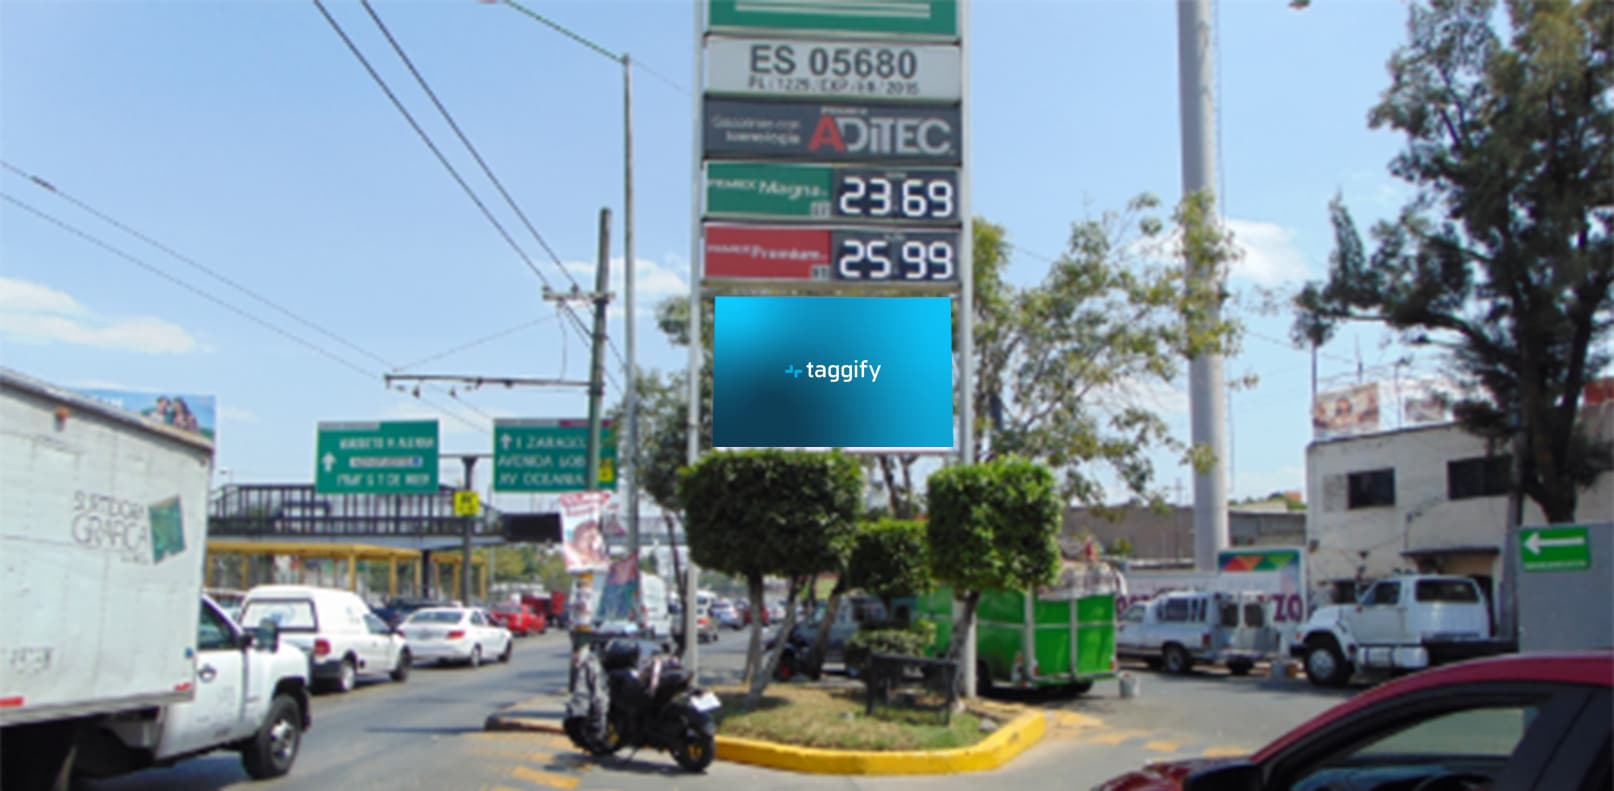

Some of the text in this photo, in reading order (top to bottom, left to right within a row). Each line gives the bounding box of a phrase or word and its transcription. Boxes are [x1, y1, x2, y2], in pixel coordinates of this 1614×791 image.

[751, 45, 917, 79] ES 05680
[758, 180, 821, 201] Magna
[806, 360, 881, 383] taggify
